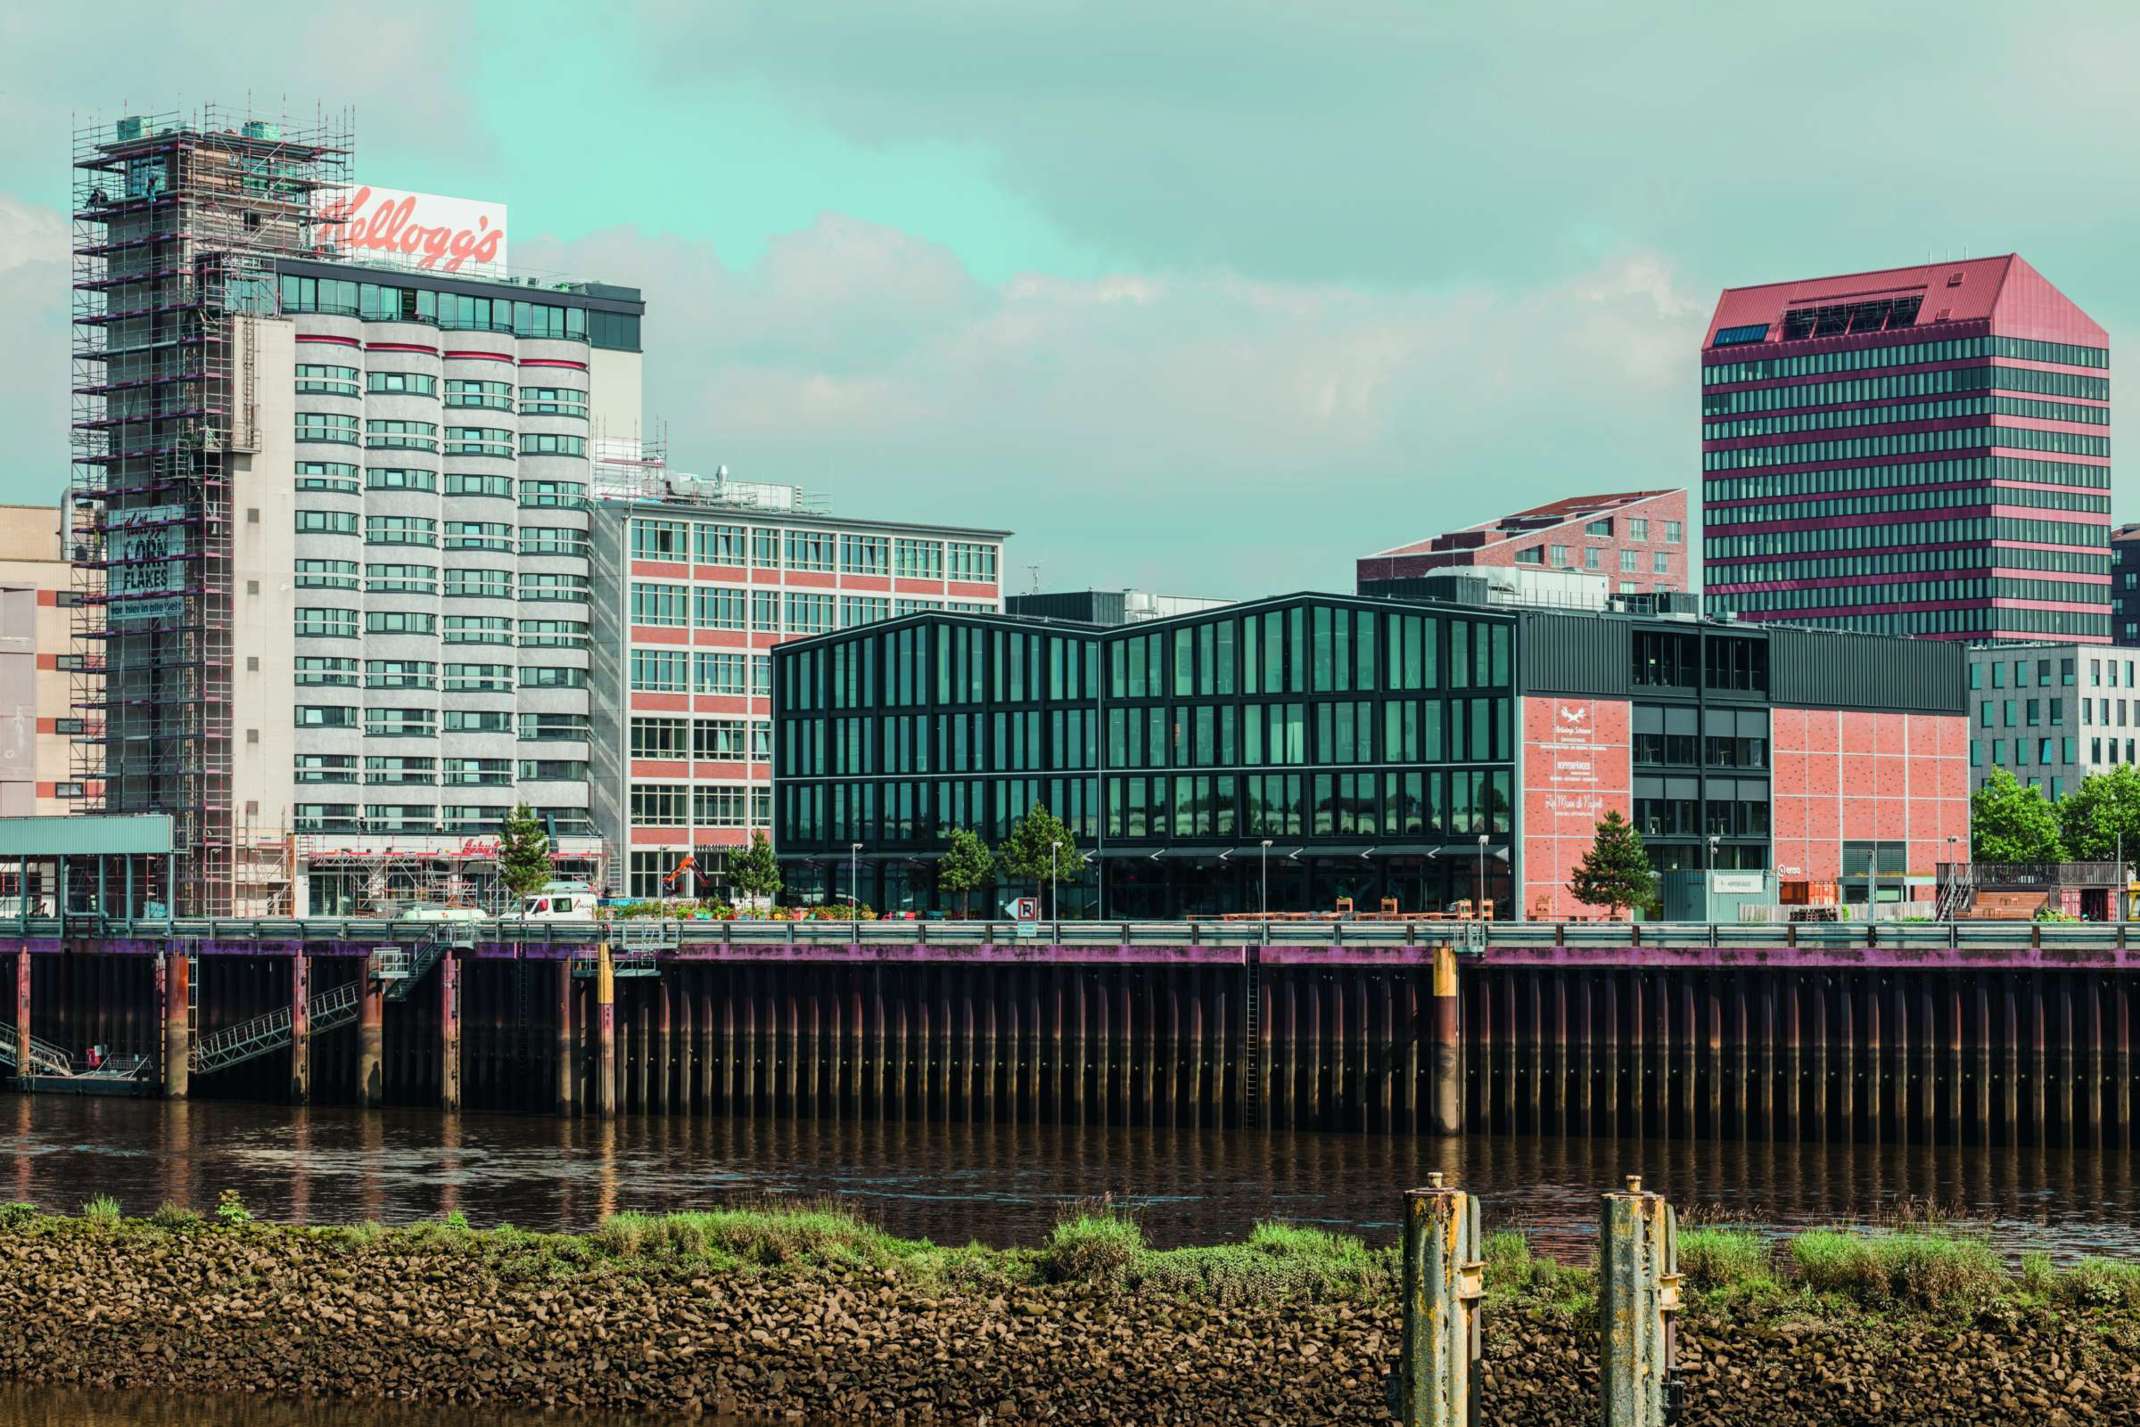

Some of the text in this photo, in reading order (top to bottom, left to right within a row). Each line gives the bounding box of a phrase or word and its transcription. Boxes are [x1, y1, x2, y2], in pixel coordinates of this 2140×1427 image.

[314, 186, 503, 272] Kellogg's
[125, 540, 168, 569] CORN
[124, 570, 168, 589] FLAKES
